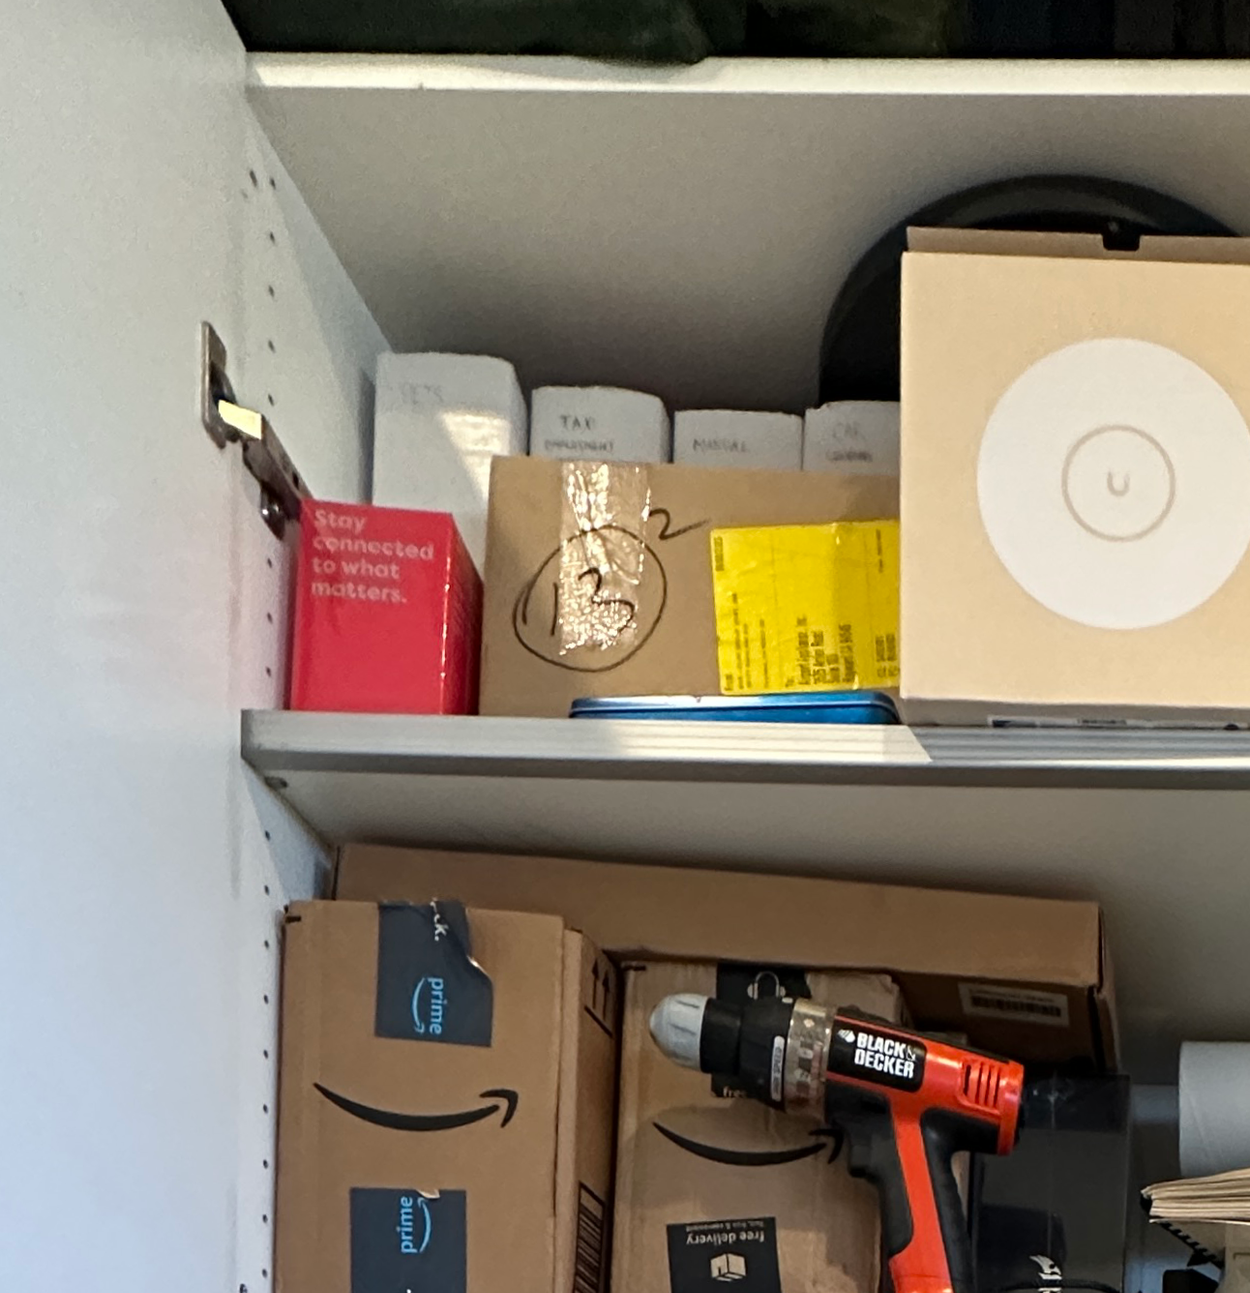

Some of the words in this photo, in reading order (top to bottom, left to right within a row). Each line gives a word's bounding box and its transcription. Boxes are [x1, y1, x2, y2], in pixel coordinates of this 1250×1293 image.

[314, 509, 367, 535] Stay
[312, 537, 435, 560] connected
[312, 556, 337, 574] to
[341, 558, 400, 580] what
[311, 581, 408, 603] matters.
[427, 977, 448, 1035] prime
[854, 1049, 916, 1079] DECKER
[396, 1196, 418, 1254] prime
[686, 1230, 737, 1246] delivery
